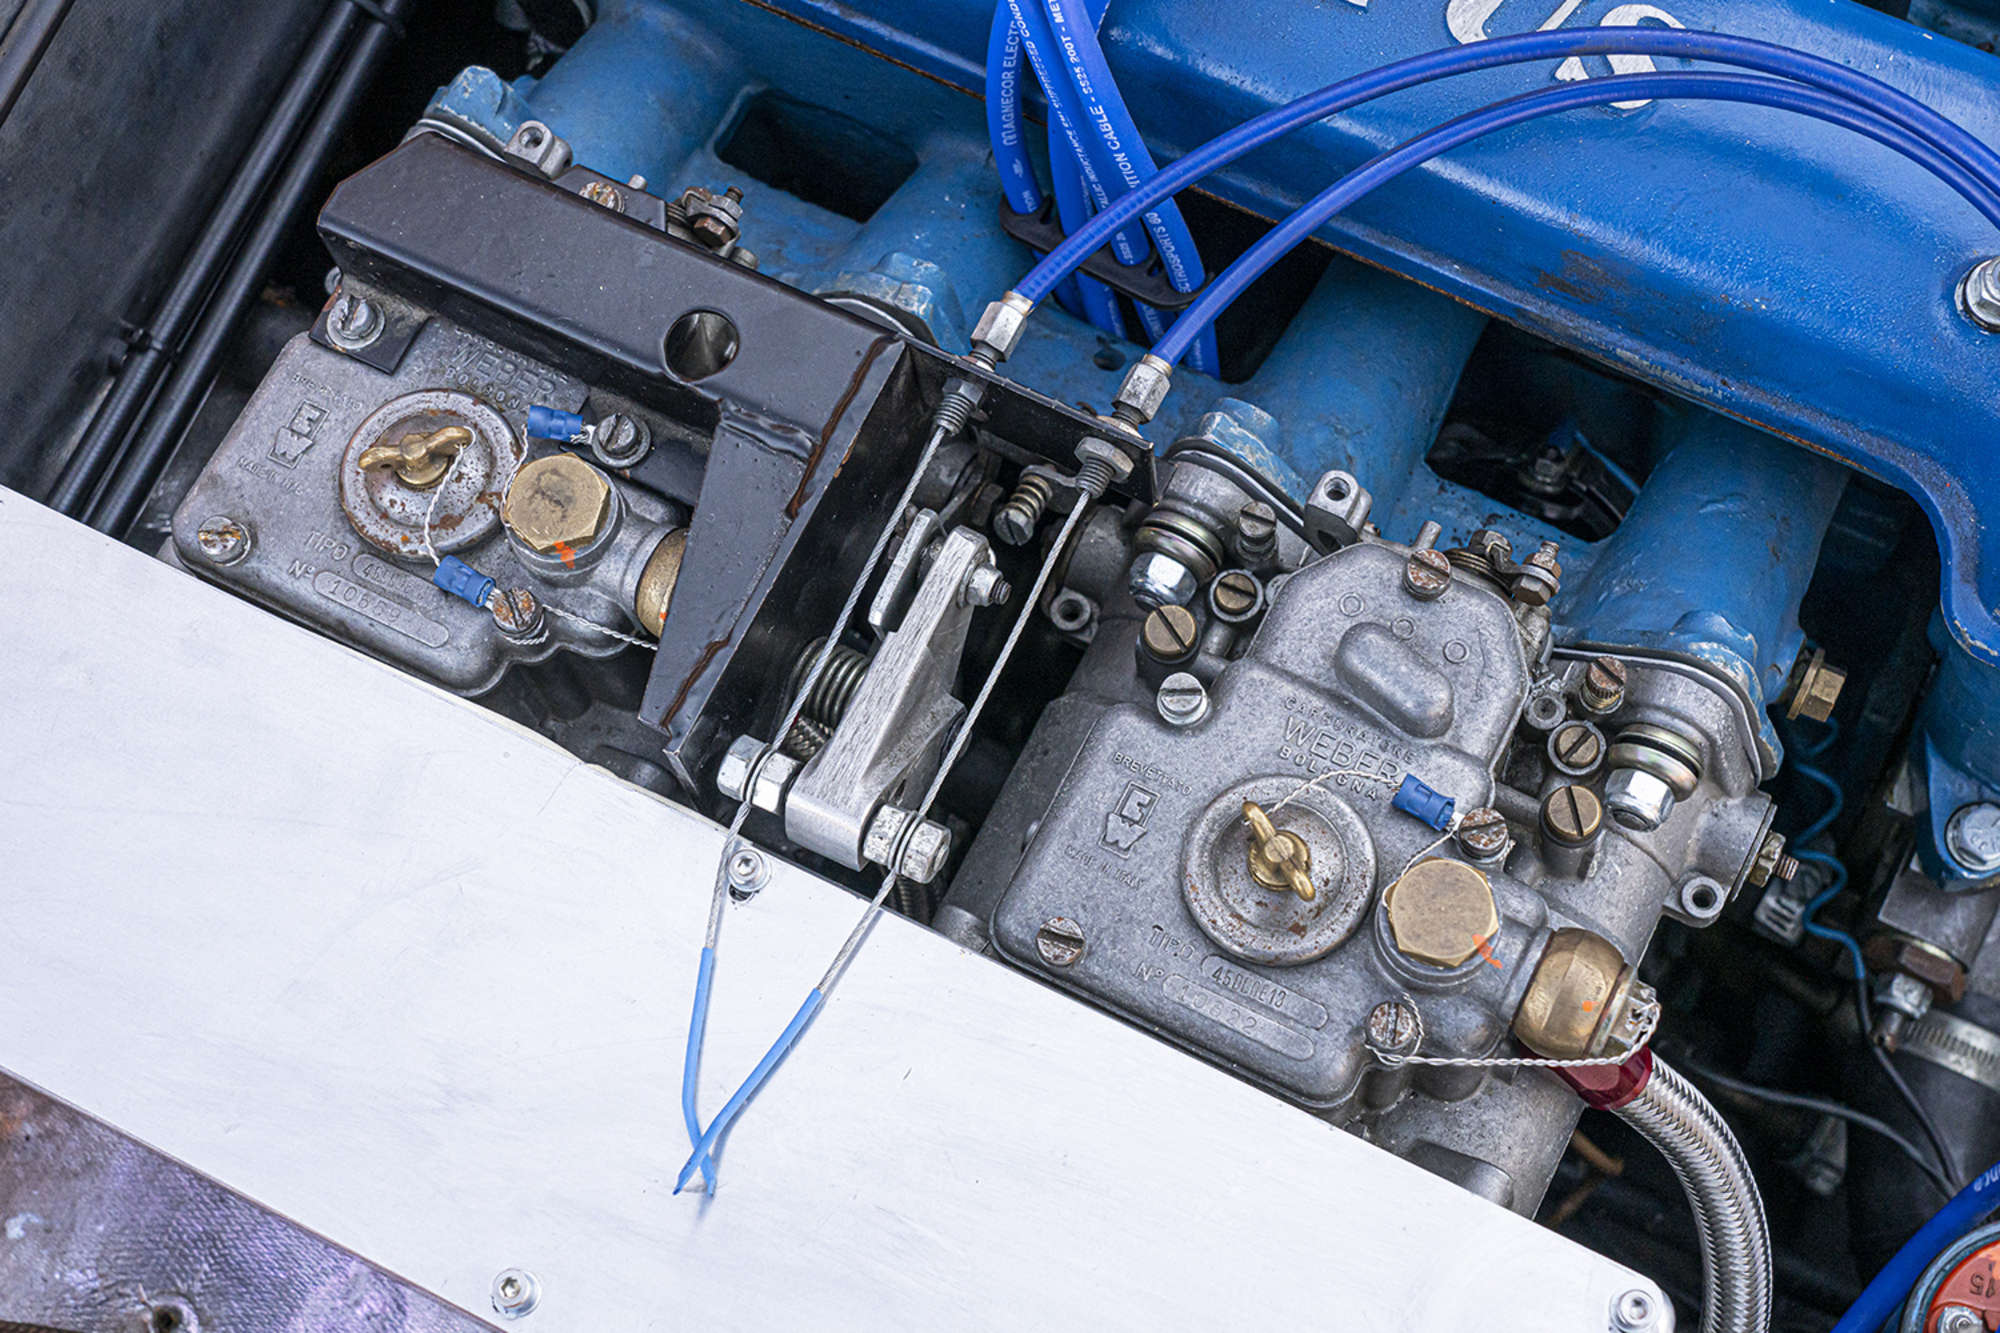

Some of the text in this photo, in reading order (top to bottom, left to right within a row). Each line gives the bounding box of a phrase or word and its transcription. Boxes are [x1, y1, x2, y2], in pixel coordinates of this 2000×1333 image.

[1061, 35, 1080, 64] 200T
[1001, 70, 1018, 146] MAGNECOR
[1090, 104, 1121, 150] CABLE
[1113, 153, 1141, 188] ITION
[450, 341, 556, 399] WEBER
[305, 531, 349, 561] TIPO
[1284, 716, 1402, 784] WEBER
[1112, 751, 1193, 797] BREVETTATO
